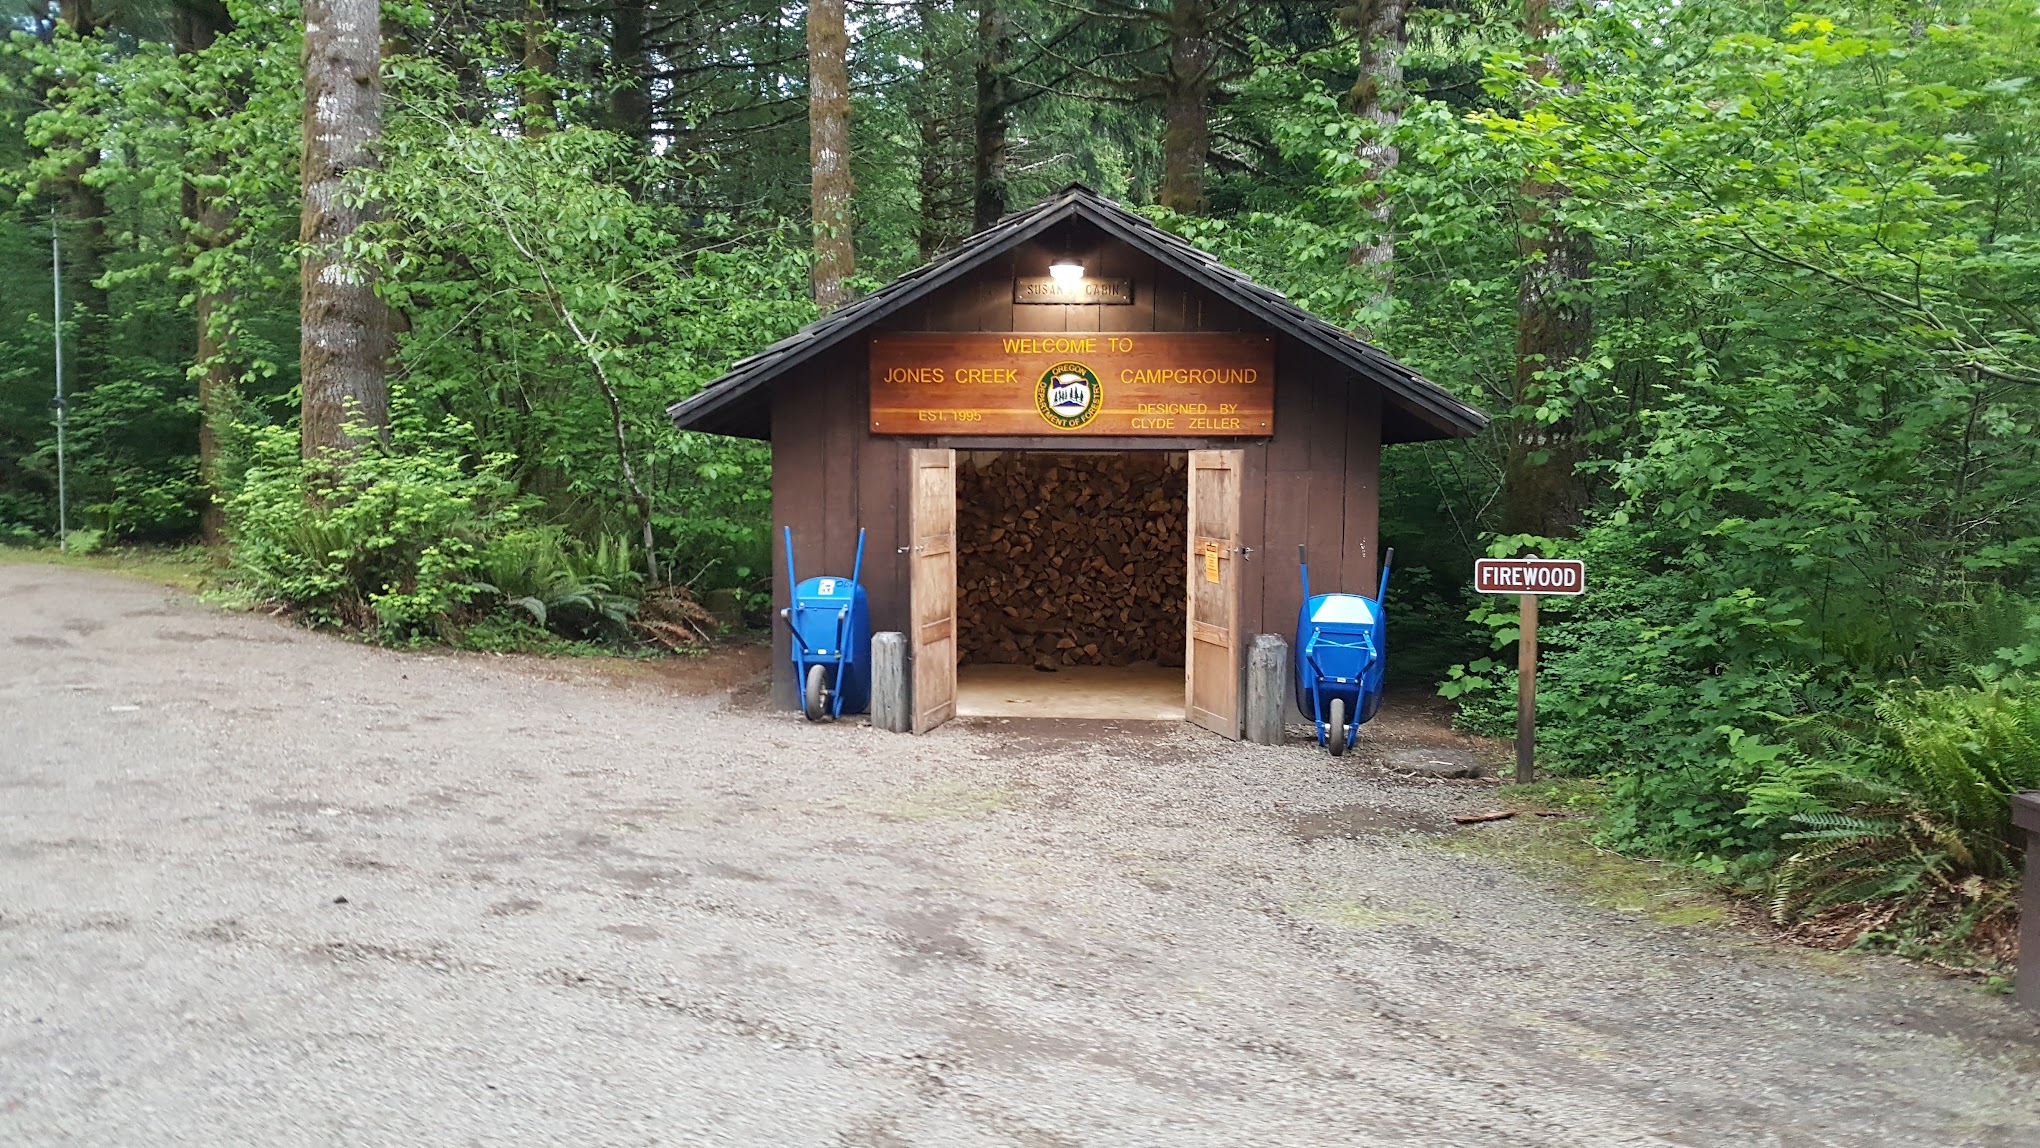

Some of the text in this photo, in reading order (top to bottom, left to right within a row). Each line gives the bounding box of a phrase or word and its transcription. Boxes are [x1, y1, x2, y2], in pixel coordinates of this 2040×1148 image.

[1027, 284, 1119, 296] SUSAN CABIN
[1003, 337, 1133, 353] WELCOME TO
[883, 368, 1018, 383] JONES CREEK
[1052, 364, 1087, 376] OREGON
[1120, 368, 1257, 384] CAMPGROUND
[1038, 381, 1101, 427] DEPARTMENT OF FORESTRY
[1138, 403, 1238, 414] DESIGNED BY
[918, 410, 982, 421] EST. 1995
[1131, 417, 1240, 429] CLYDE ZELLER
[1482, 566, 1576, 587] FIREWOOD
